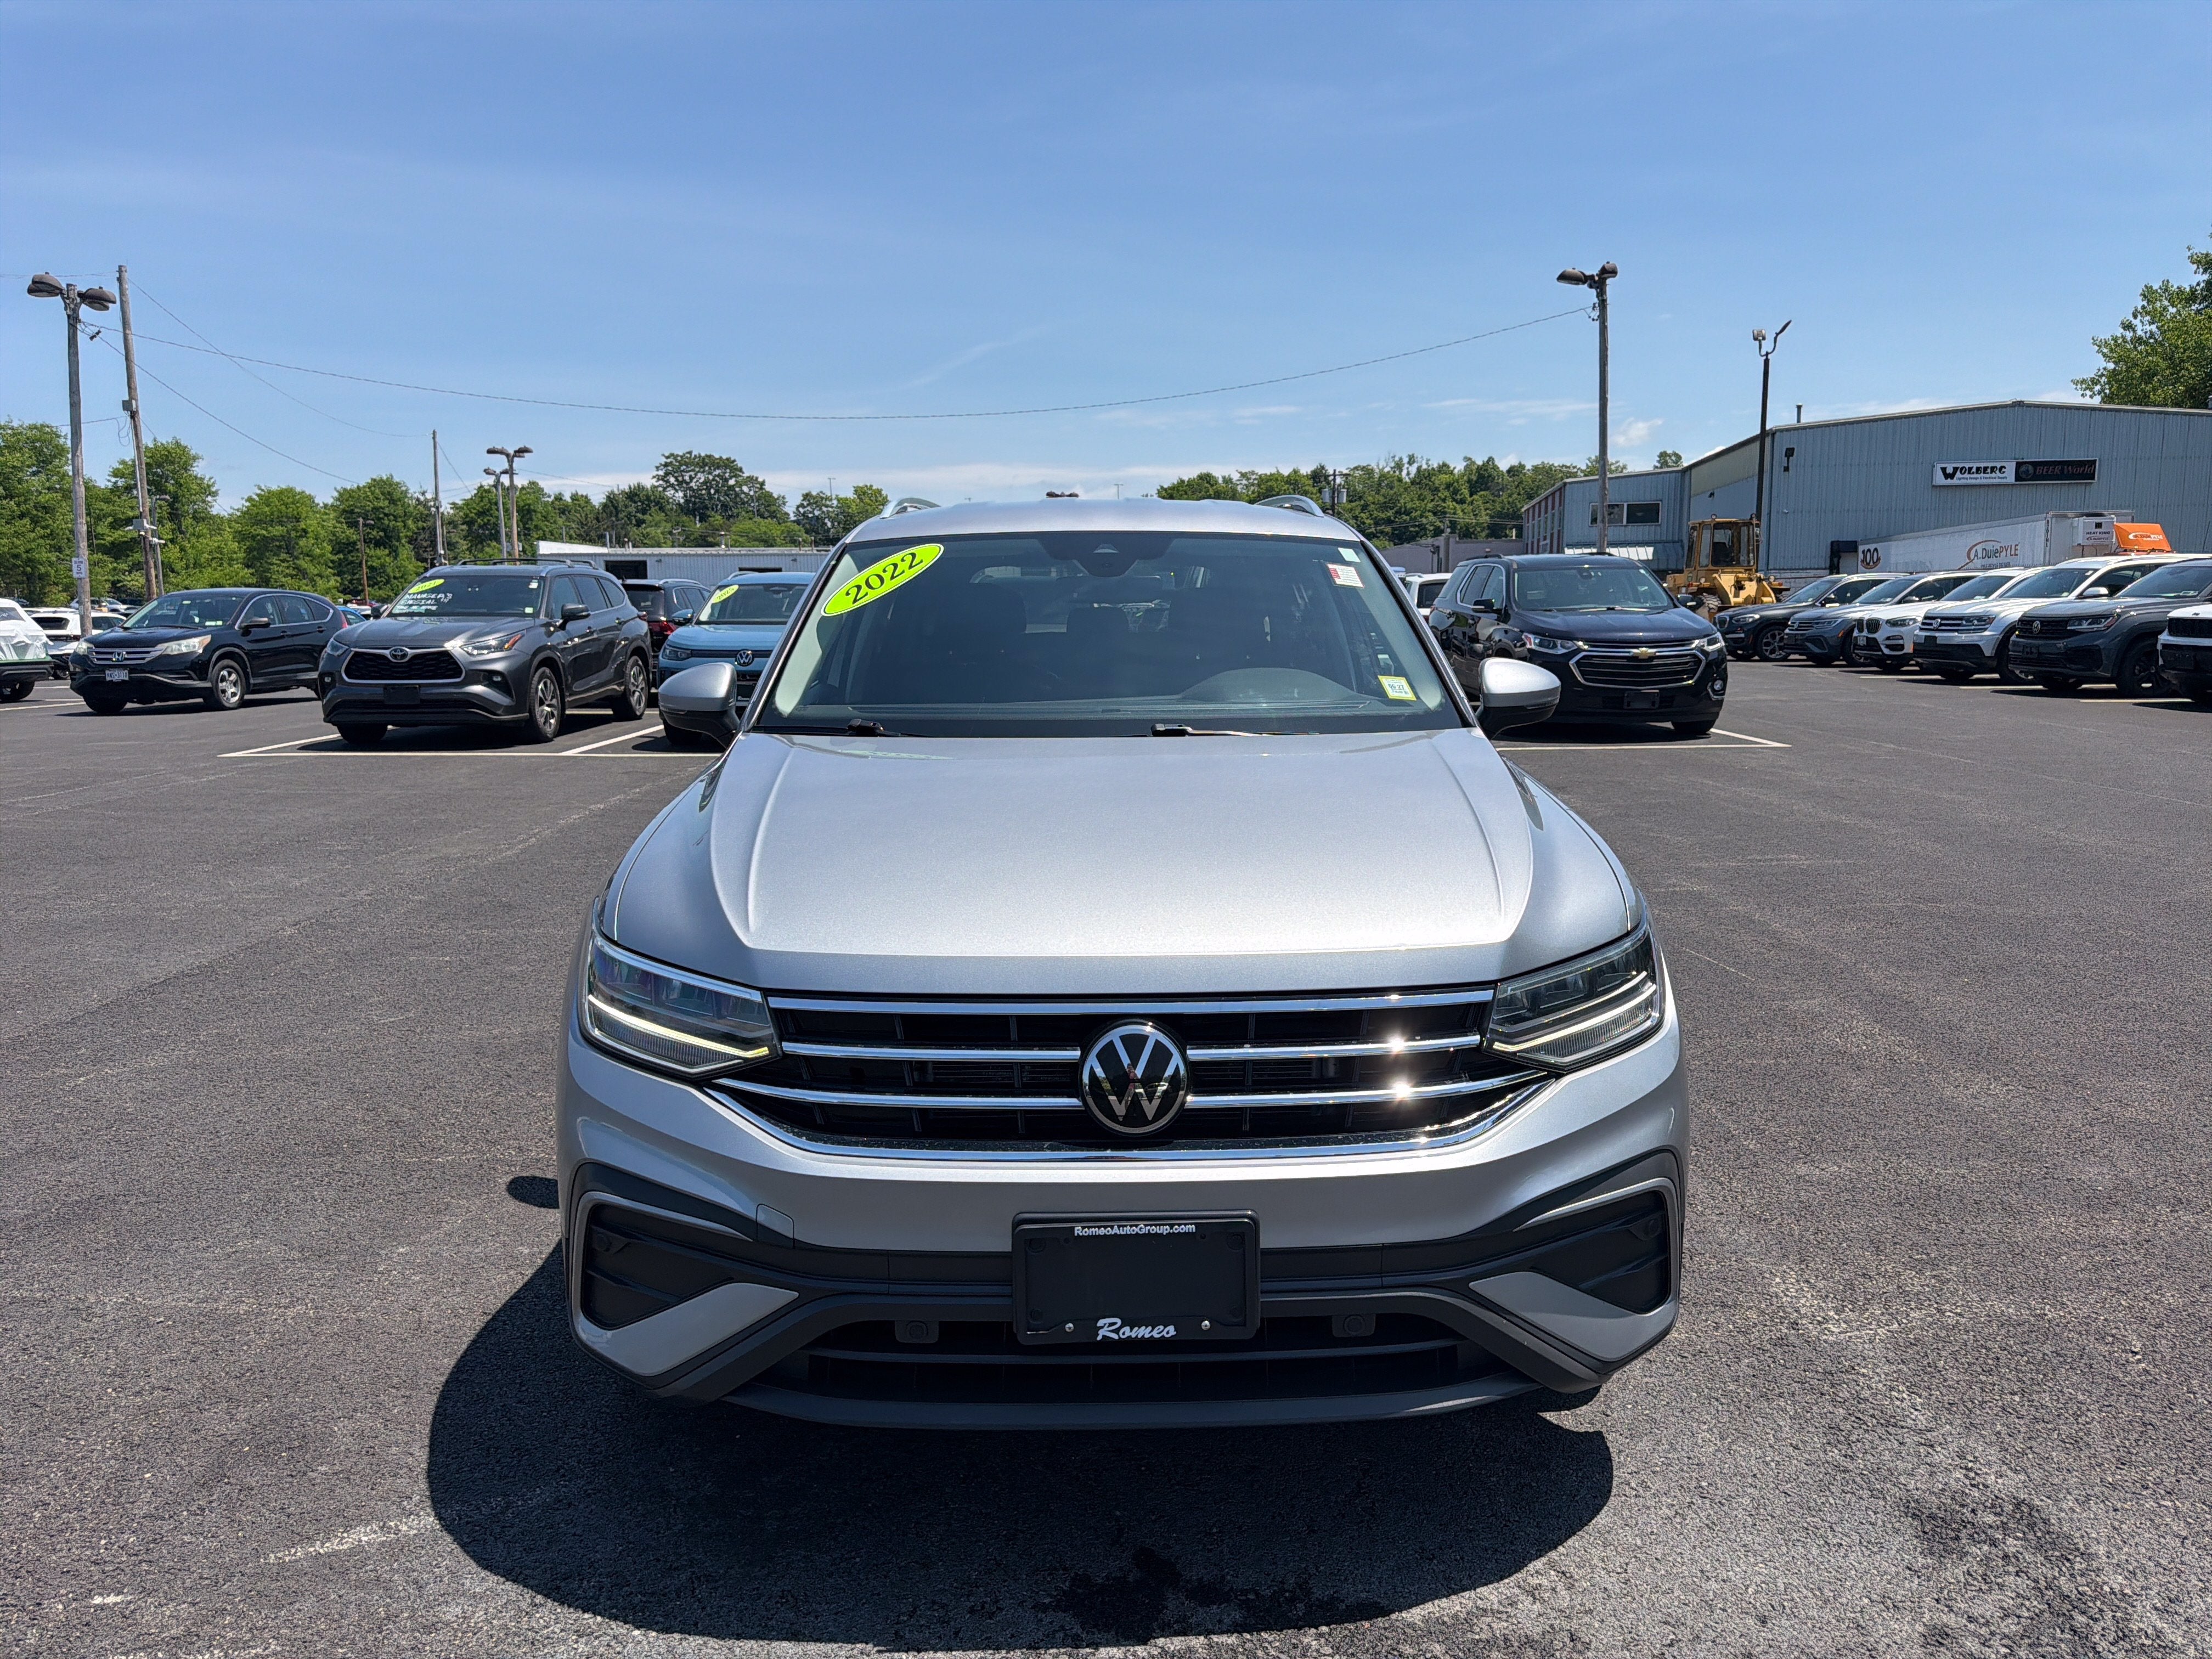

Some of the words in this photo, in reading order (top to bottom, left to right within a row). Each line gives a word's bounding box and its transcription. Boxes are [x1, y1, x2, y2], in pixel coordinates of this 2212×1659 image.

[1940, 465, 2007, 481] WOLBERG
[2036, 465, 2061, 475] BEER
[2064, 464, 2095, 475] World
[1861, 548, 1879, 565] 100
[845, 552, 924, 605] 2022
[1074, 1224, 1196, 1236] RomeoAutoGroup.com
[1096, 1317, 1177, 1341] Romeo
